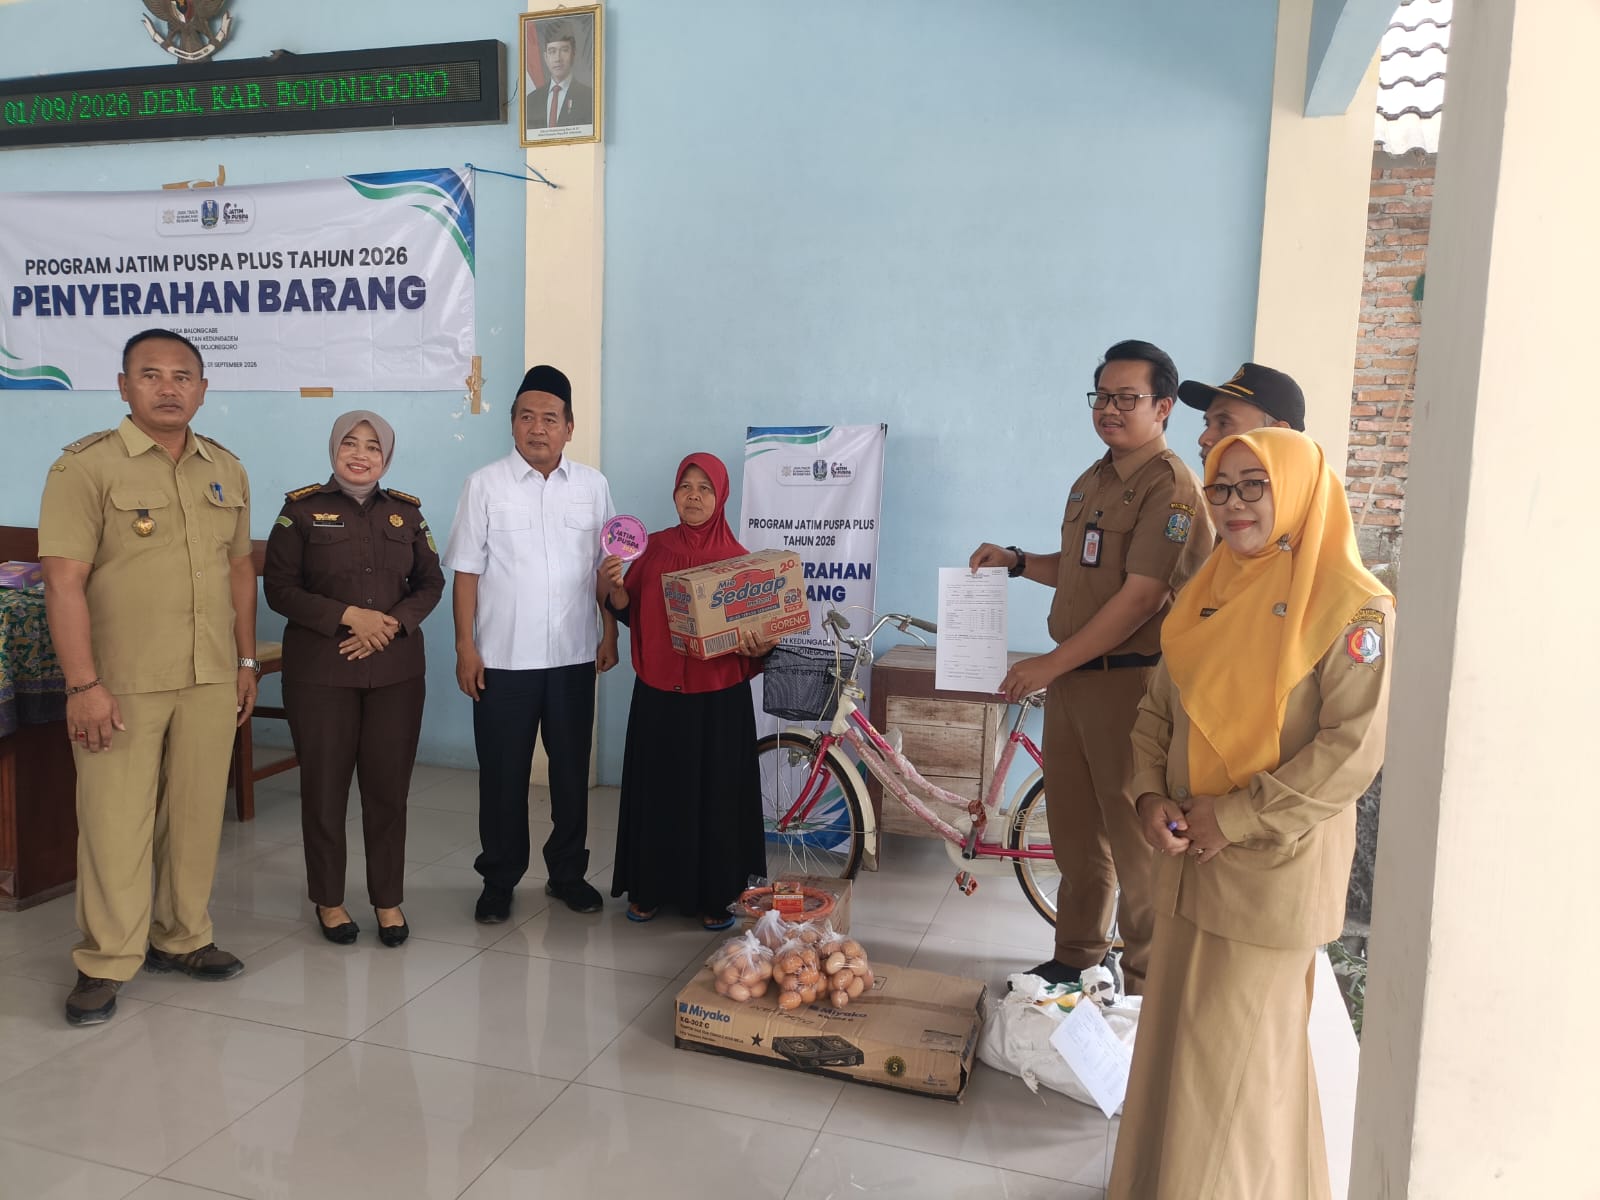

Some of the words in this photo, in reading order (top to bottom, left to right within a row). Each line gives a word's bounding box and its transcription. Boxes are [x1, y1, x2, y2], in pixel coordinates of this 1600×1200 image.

[4, 91, 131, 125] 01/09/2026
[211, 83, 269, 110] KAB.
[276, 70, 449, 111] BOJONEGORO
[25, 256, 111, 276] PROGRAM
[115, 255, 169, 273] JATIM
[173, 252, 234, 271] PUSPA
[237, 251, 283, 270] PLUS
[287, 249, 354, 269] TAHUN
[359, 246, 408, 266] 2026
[12, 280, 250, 316] PENYERAHAN
[258, 275, 427, 312] BARANG
[748, 518, 793, 529] PROGRAM
[794, 519, 822, 530] JATIM
[823, 519, 851, 530] PUSPA
[852, 519, 875, 530] PLUS
[615, 529, 636, 541] JATIM
[616, 536, 639, 549] PUSPA
[783, 535, 814, 546] TAHUN
[815, 536, 836, 546] 2026
[801, 562, 872, 580] RAHAN
[718, 579, 736, 589] Mie
[710, 577, 787, 609] Sedaap
[805, 585, 847, 602] ANG
[770, 614, 807, 632] GORENG
[688, 1004, 731, 1023] Miyako
[891, 1063, 899, 1072] 5
